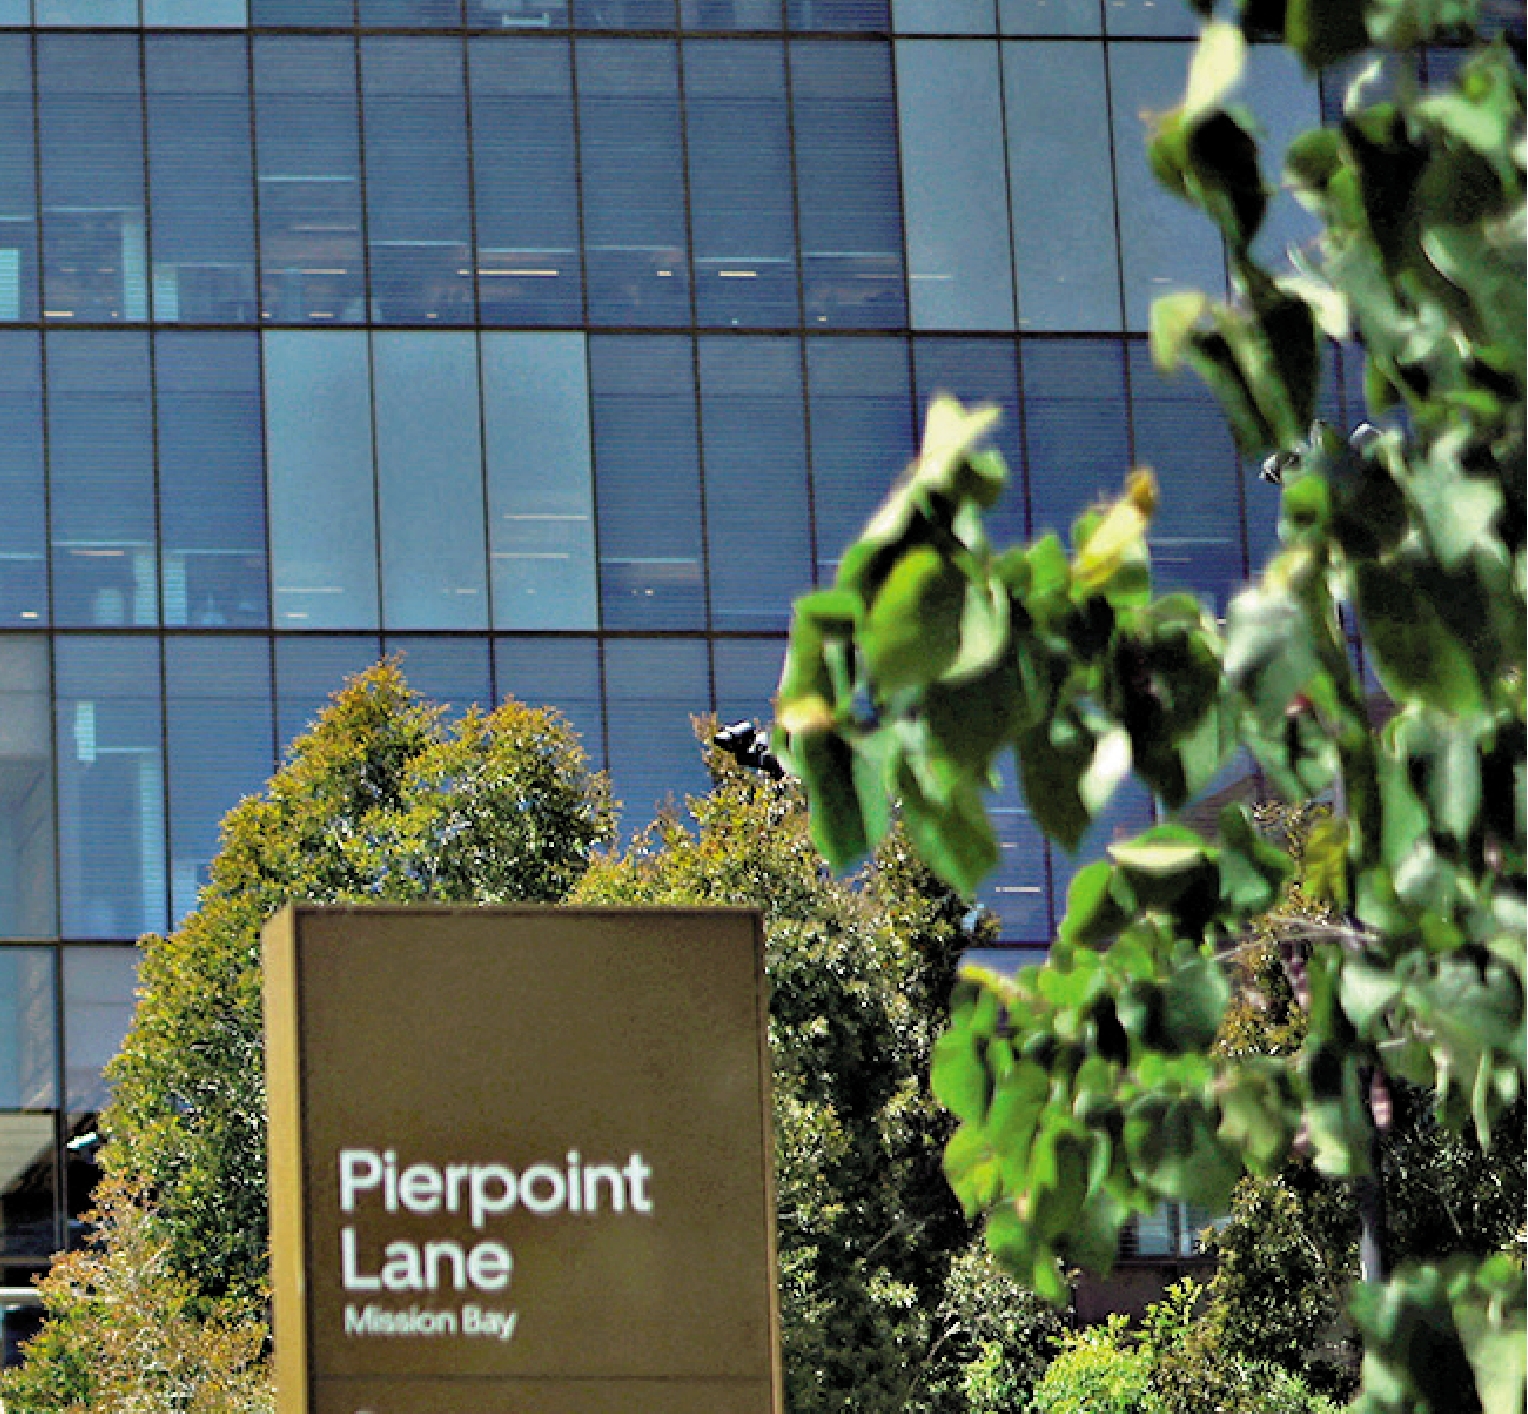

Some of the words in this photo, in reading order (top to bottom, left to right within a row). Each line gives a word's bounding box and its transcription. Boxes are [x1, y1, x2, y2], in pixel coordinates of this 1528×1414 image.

[339, 1149, 653, 1228] Pierpoint
[341, 1227, 513, 1291] Lane
[344, 1305, 456, 1335] Mission
[461, 1305, 517, 1341] Bay
